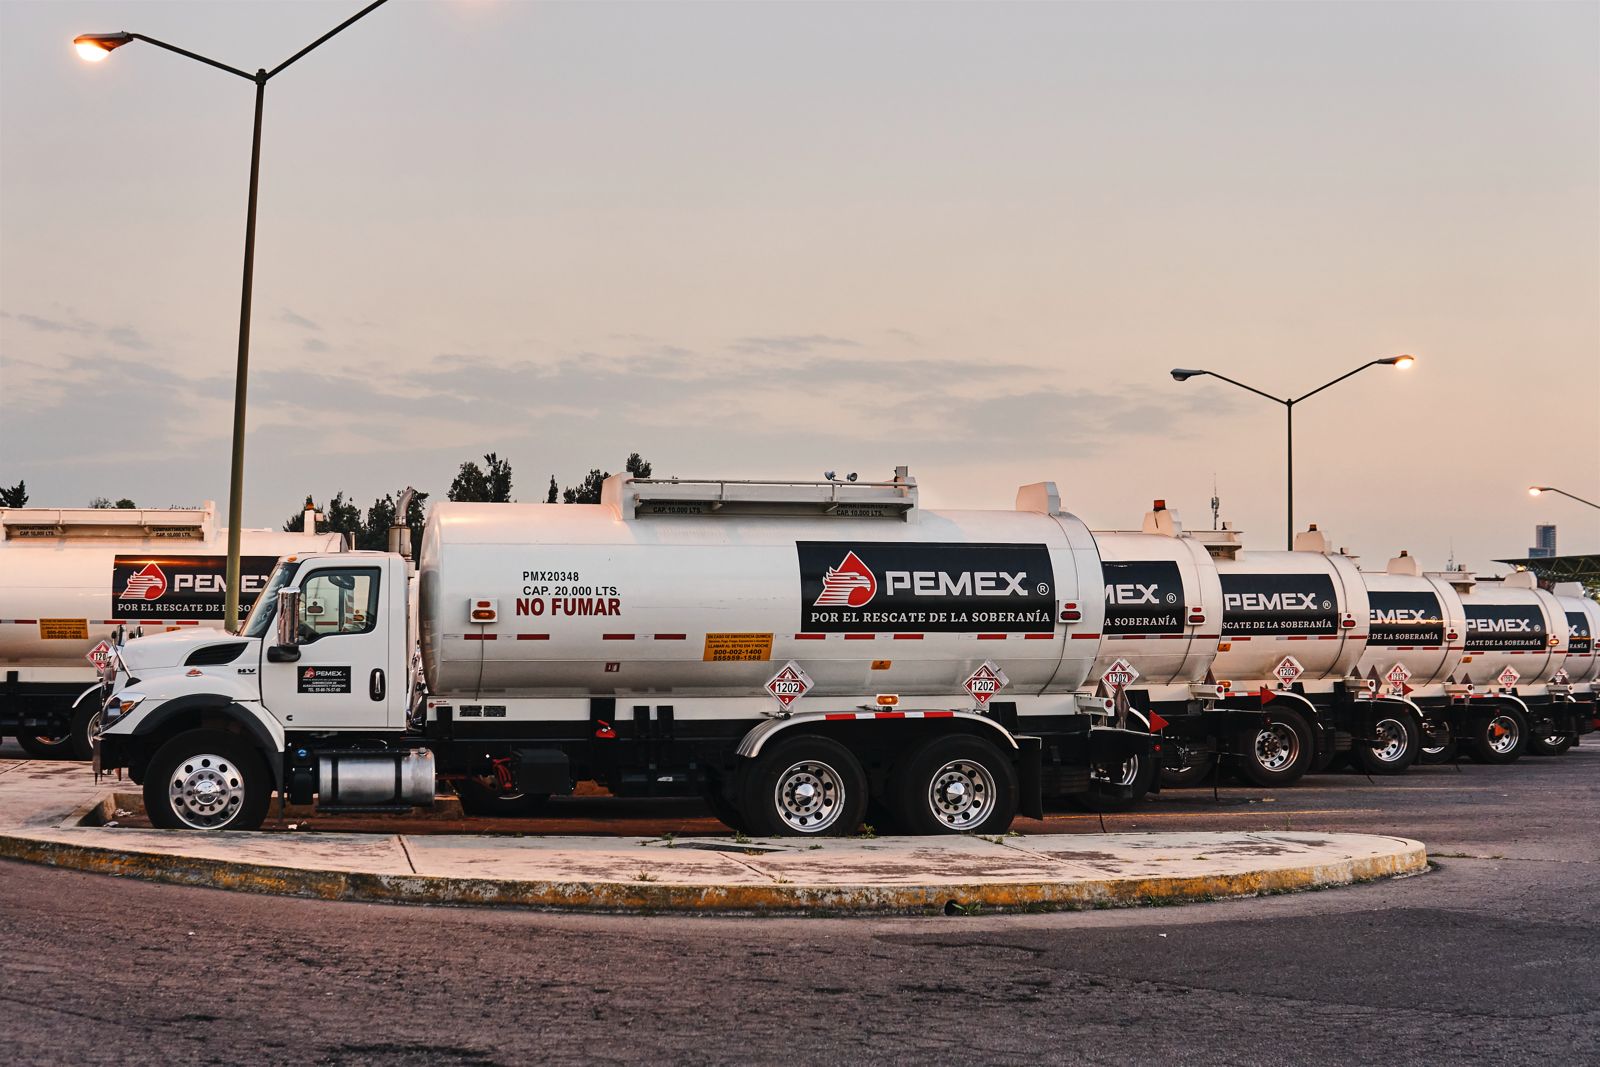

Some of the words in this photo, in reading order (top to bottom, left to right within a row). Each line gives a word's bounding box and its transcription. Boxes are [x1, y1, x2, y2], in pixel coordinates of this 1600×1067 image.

[522, 571, 580, 581] PMX20348
[885, 570, 1029, 596] PEMEX
[523, 586, 551, 596] CAP.
[555, 586, 592, 596] 20,000
[595, 586, 621, 596] LTS.
[1224, 592, 1318, 610] PEMEX
[516, 598, 545, 616] NO
[552, 598, 622, 616] FUMAR
[810, 612, 839, 623] POR
[842, 612, 860, 623] EL
[862, 612, 926, 623] RESCATE
[930, 612, 946, 623] DE
[950, 612, 968, 623] LA
[971, 610, 1050, 622] SOBERANÍA
[1114, 615, 1177, 626] SOBERANÍA
[1254, 621, 1264, 629] DE
[1280, 618, 1332, 628] SOBERANÍA
[1466, 618, 1530, 632] PEMEX
[1395, 632, 1438, 640] SOBERANÍA
[1110, 674, 1128, 682] 1202
[777, 682, 800, 692] 1202
[973, 682, 994, 690] 1202
